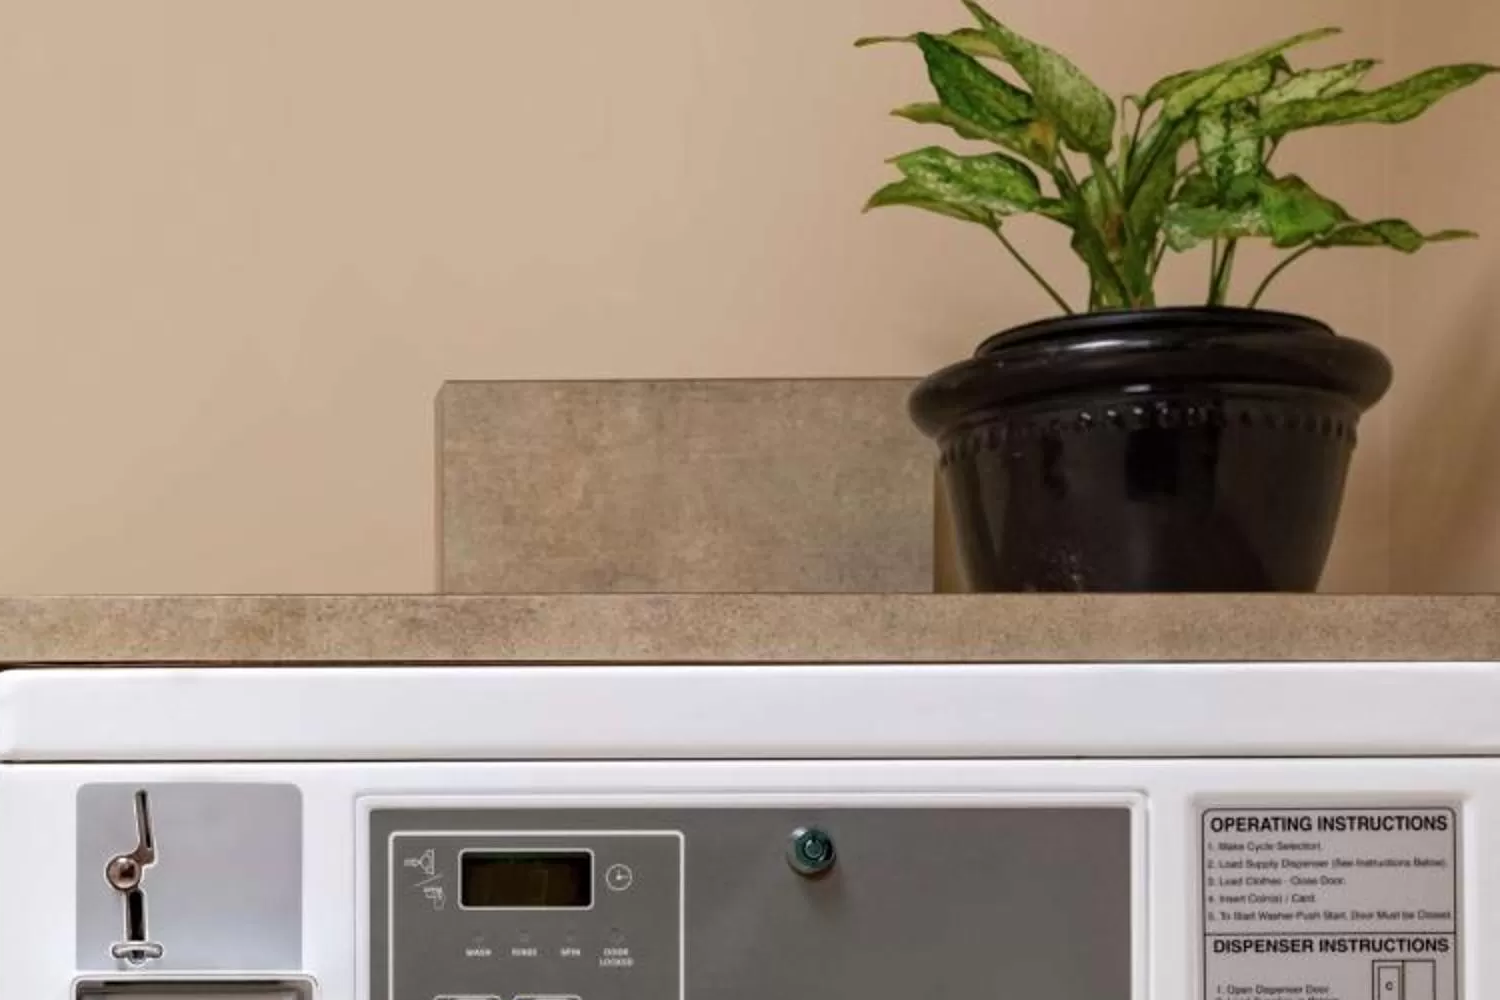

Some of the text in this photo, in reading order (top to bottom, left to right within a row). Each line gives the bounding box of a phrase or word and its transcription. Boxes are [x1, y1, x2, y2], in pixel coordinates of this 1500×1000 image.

[1210, 815, 1448, 832] OPERATING INSTRUCTIONS
[1218, 842, 1245, 851] Make
[1246, 841, 1274, 853] Cycle
[1218, 859, 1243, 869] Load
[1245, 859, 1279, 871] Supply
[1280, 859, 1329, 870] Dispenser
[1219, 876, 1243, 886] Load
[1219, 895, 1246, 903] Insert
[1220, 911, 1231, 920] To
[1233, 911, 1256, 920] Start
[1375, 910, 1400, 920] Must
[1213, 937, 1450, 953] DISPENSER INSTRUCTIONS
[1226, 983, 1253, 996] Open
[1254, 983, 1303, 995] Dispenser
[1385, 980, 1394, 991] C
